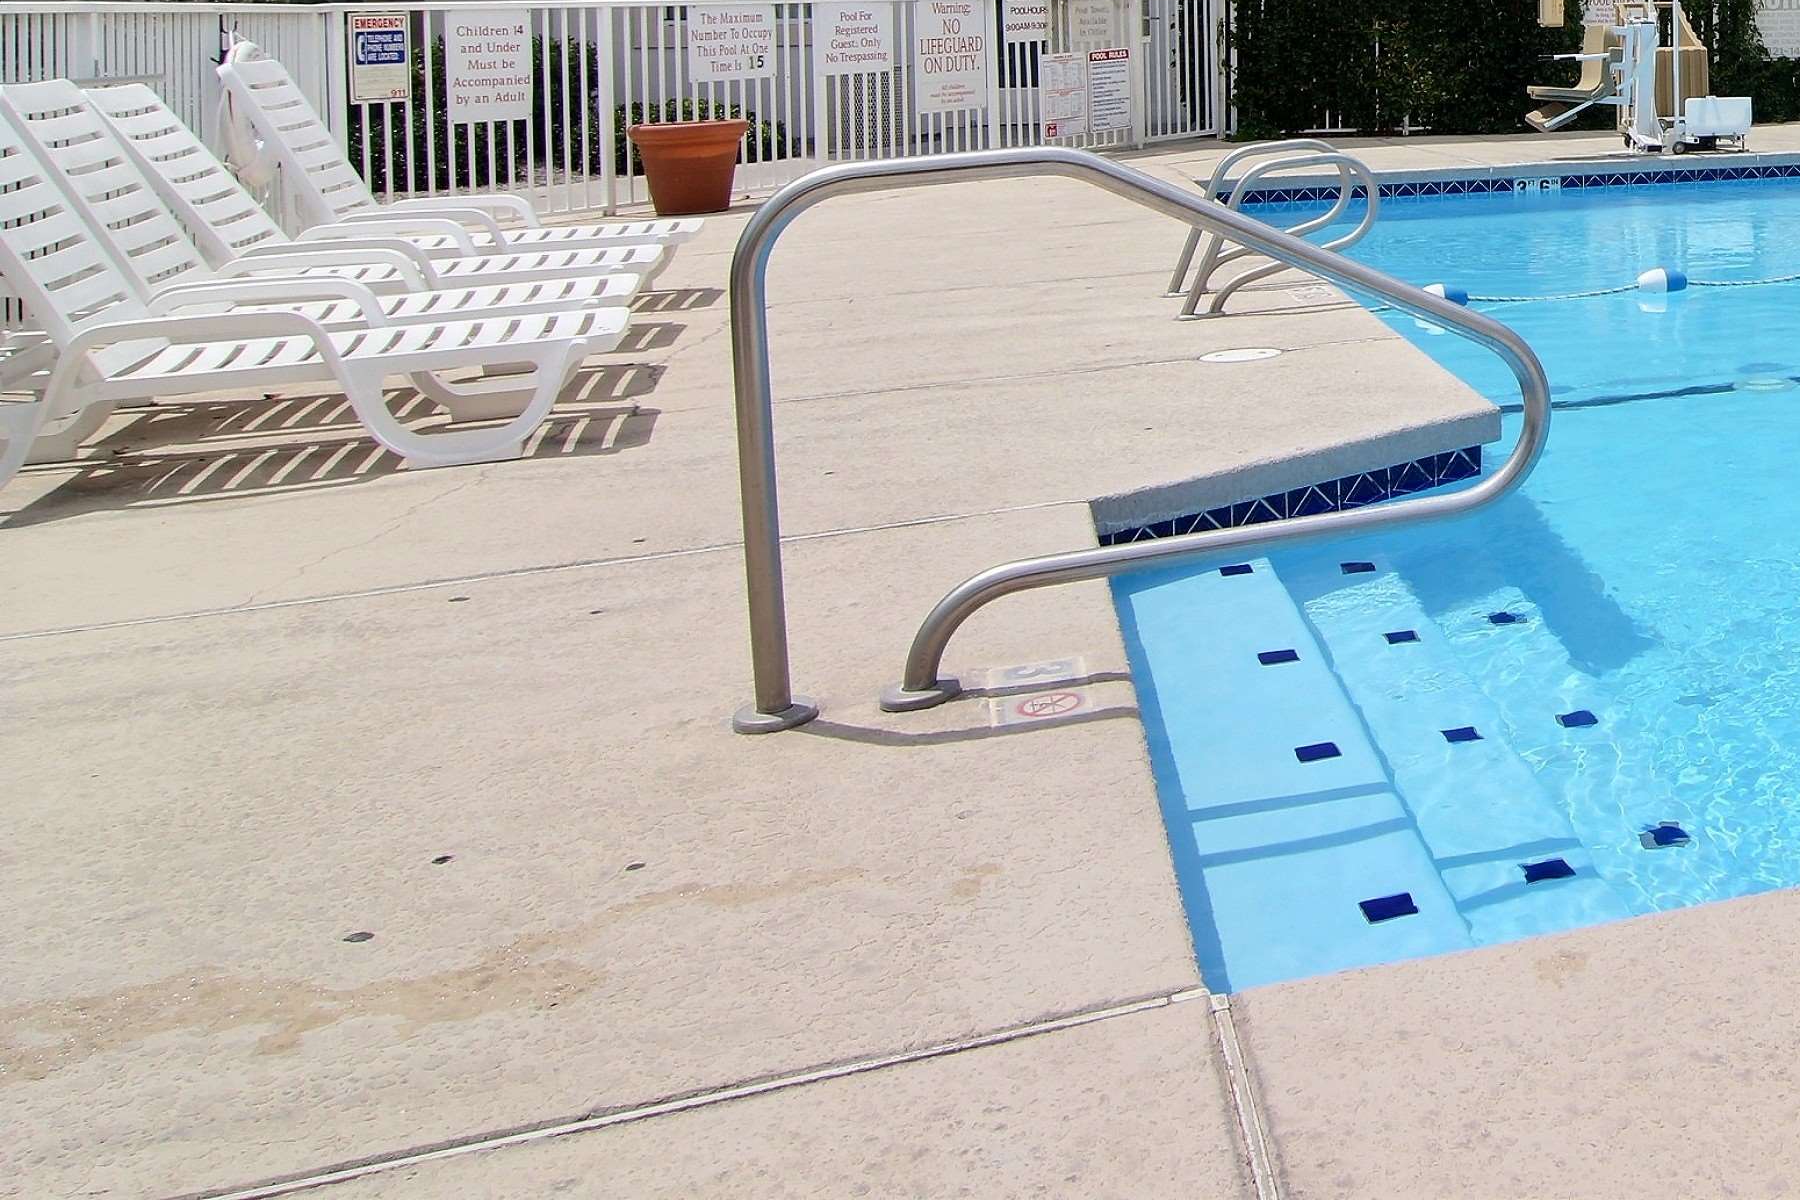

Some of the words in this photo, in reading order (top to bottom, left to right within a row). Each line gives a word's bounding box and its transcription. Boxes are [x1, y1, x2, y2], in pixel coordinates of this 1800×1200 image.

[700, 12, 718, 25] The
[720, 12, 763, 25] Maximum
[840, 11, 857, 21] Pool
[859, 10, 873, 21] For
[355, 18, 405, 29] EMERGENCY
[942, 18, 961, 35] NO
[456, 25, 509, 37] Children
[513, 24, 524, 36] 14
[691, 29, 727, 41] Number
[730, 27, 740, 40] To
[741, 27, 772, 41] Occupy
[834, 24, 879, 37] Registered
[460, 43, 482, 54] and
[487, 42, 521, 53] Under
[860, 37, 881, 48] Only
[919, 36, 984, 55] LIFEGUARD
[696, 45, 716, 57] This
[719, 44, 737, 56] Pool
[740, 43, 750, 55] At
[752, 42, 769, 55] One
[1091, 52, 1108, 61] POOL
[1108, 50, 1127, 59] RULES
[710, 60, 732, 73] Time
[749, 55, 764, 70] 15
[825, 53, 838, 63] No
[839, 52, 888, 63] Trespassing
[924, 57, 942, 74] ON
[945, 54, 980, 72] DUTY.
[467, 59, 497, 71] Must
[502, 59, 516, 69] be
[452, 74, 531, 89] Accompanied
[456, 94, 470, 106] by
[474, 95, 490, 104] an
[495, 91, 526, 102] Adult
